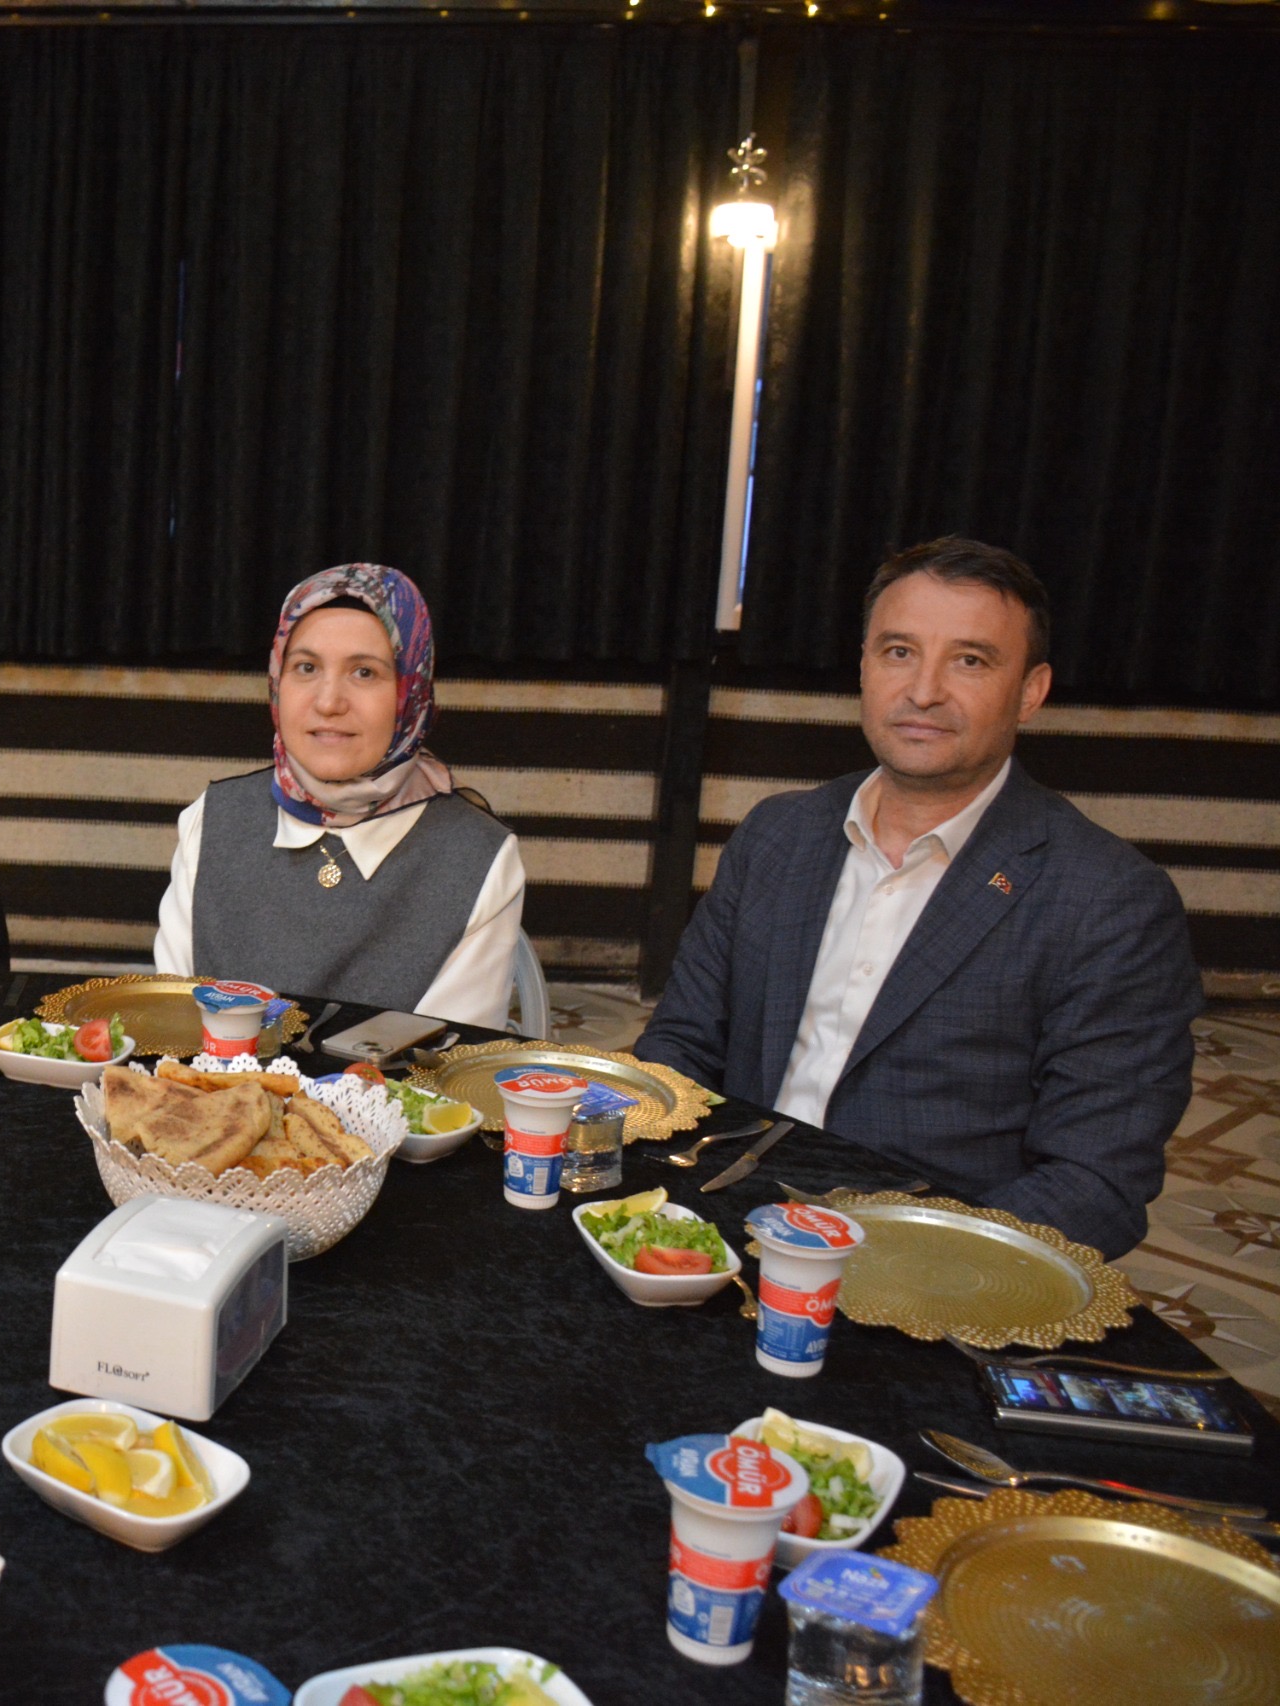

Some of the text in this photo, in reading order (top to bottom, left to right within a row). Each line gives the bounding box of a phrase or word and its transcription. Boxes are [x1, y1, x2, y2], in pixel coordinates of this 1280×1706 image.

[517, 1074, 574, 1089] ÖMÜR
[793, 1207, 843, 1238] ÖMÜR
[737, 1445, 763, 1497] ÖMÜR
[143, 1665, 204, 1706] MÜR
